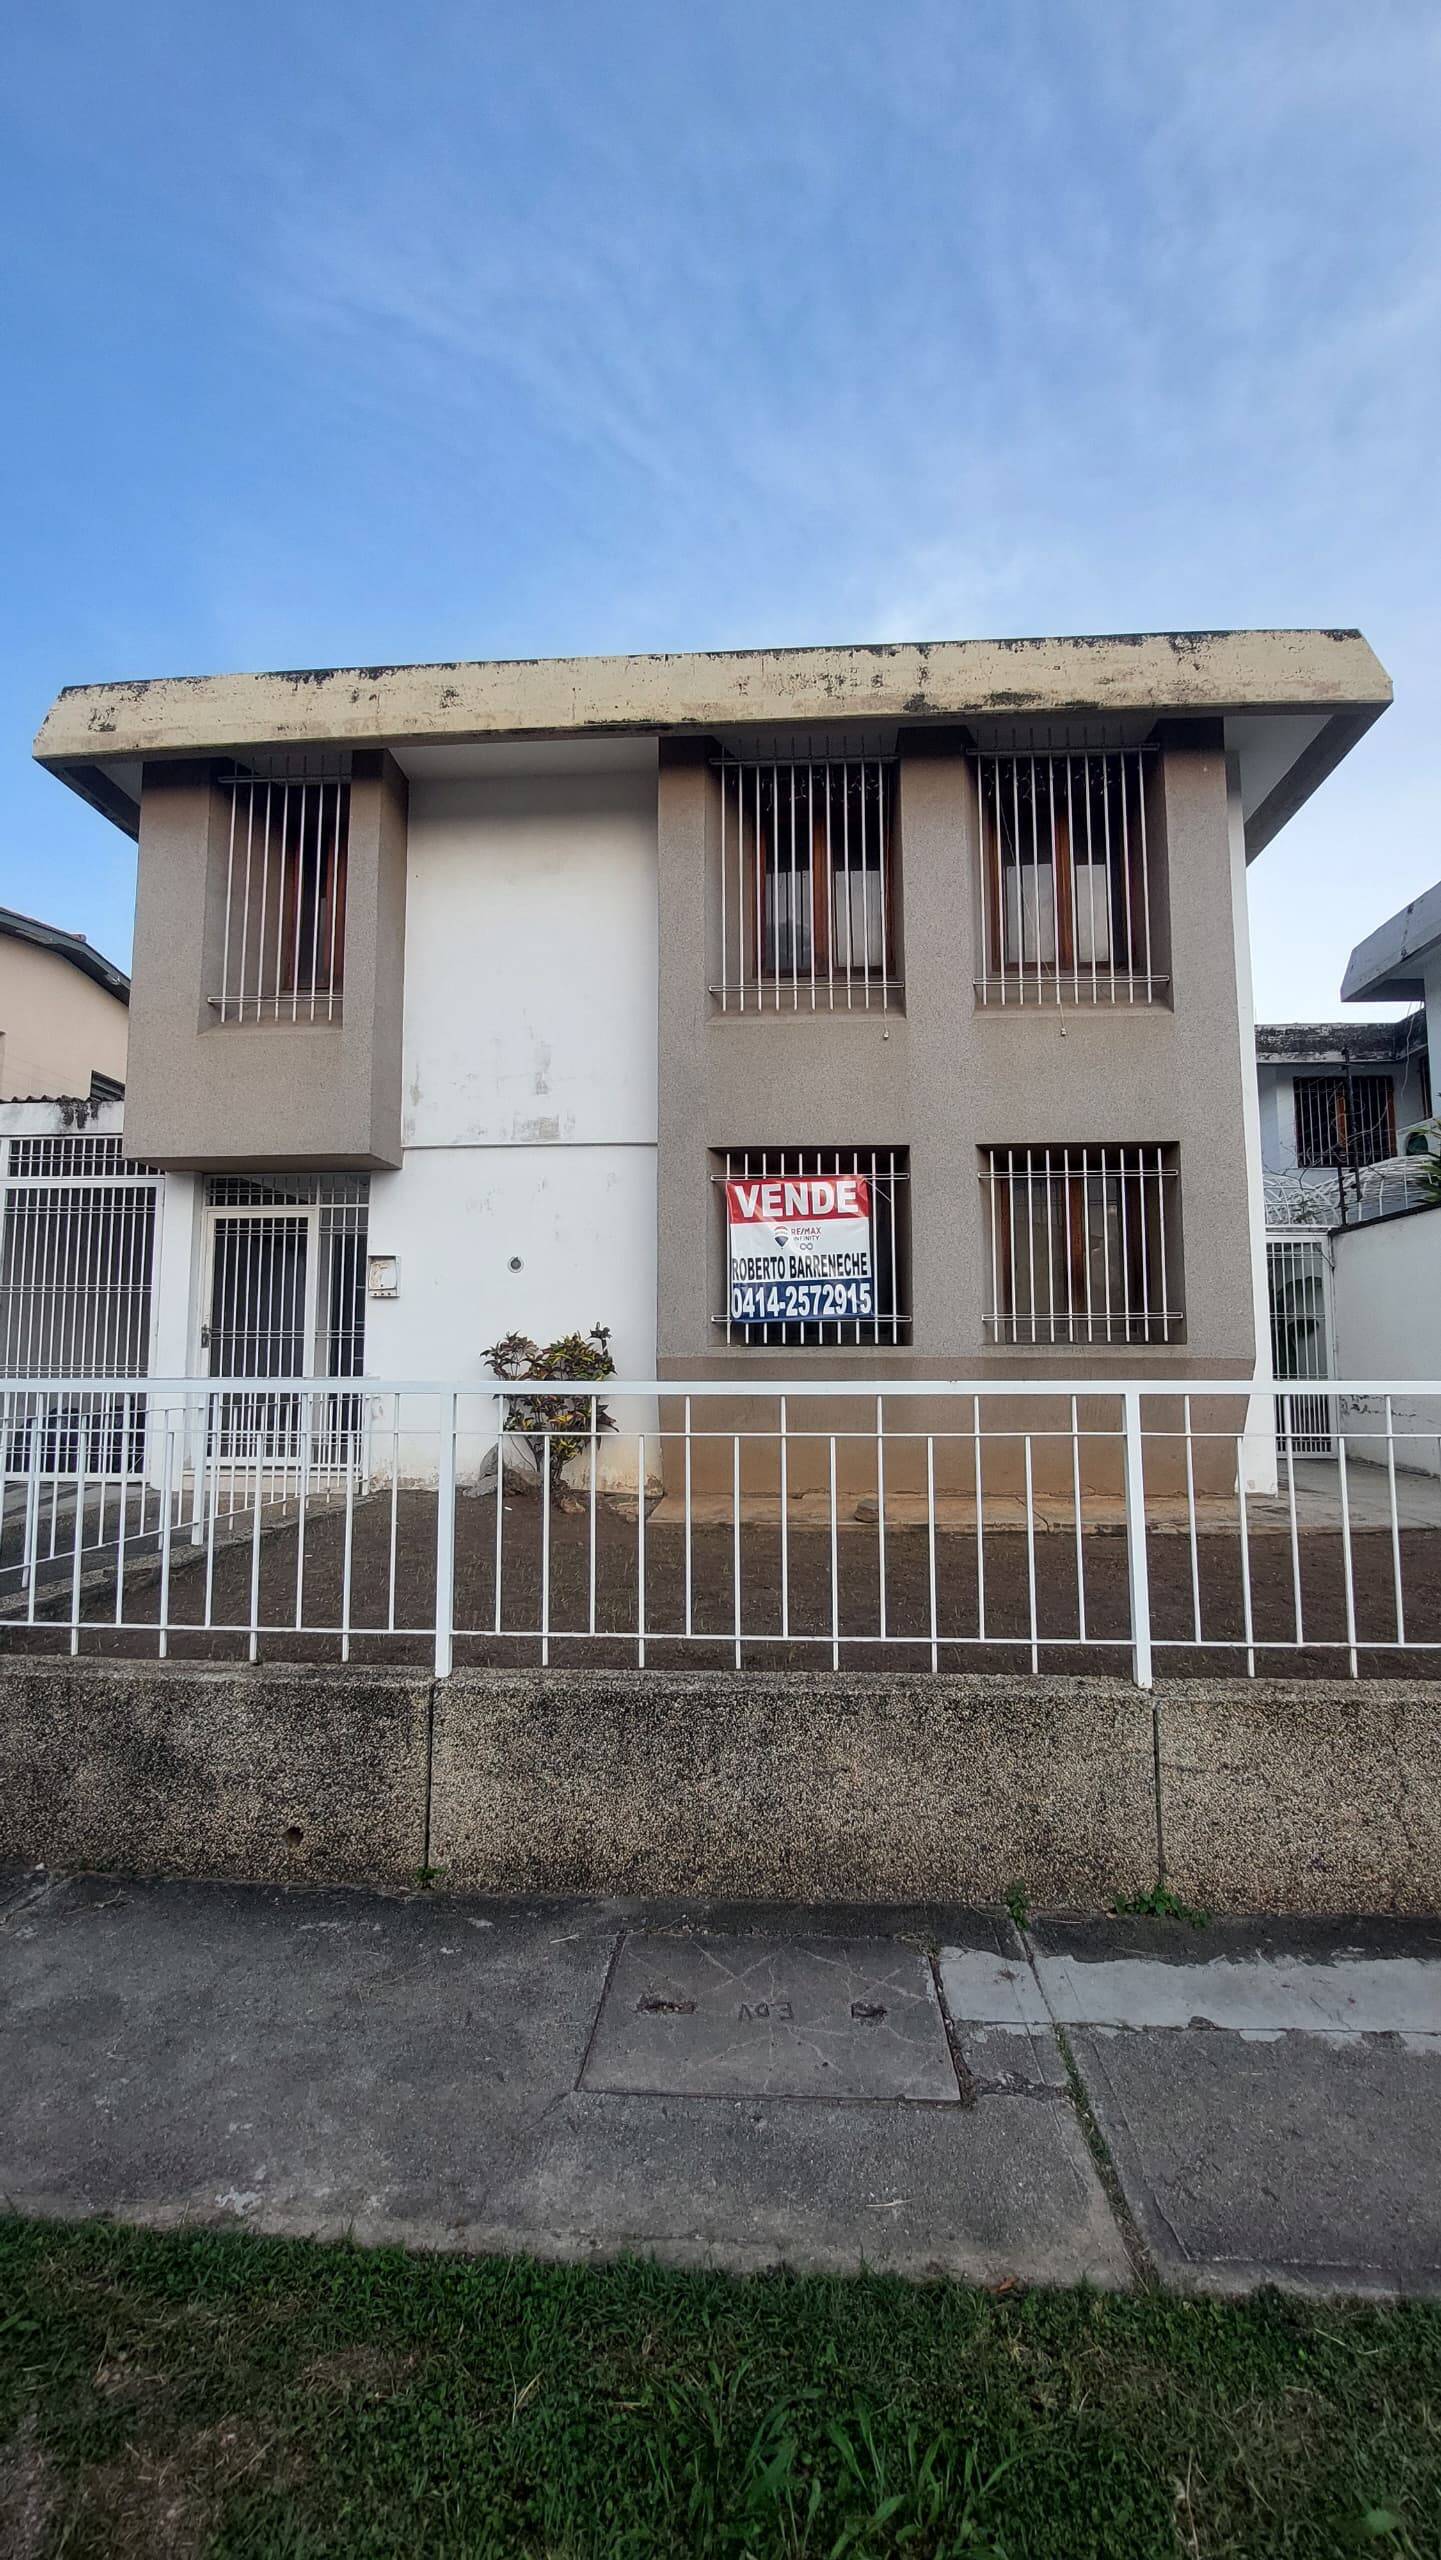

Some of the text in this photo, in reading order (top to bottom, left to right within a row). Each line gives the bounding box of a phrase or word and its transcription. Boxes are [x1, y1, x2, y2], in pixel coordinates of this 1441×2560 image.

[734, 1180, 859, 1217] VENDE
[791, 1227, 822, 1236] RE/MAX
[732, 1256, 786, 1281] ROBERTO
[790, 1252, 868, 1280] BARRENECHE
[732, 1283, 872, 1318] 0414-2572915
